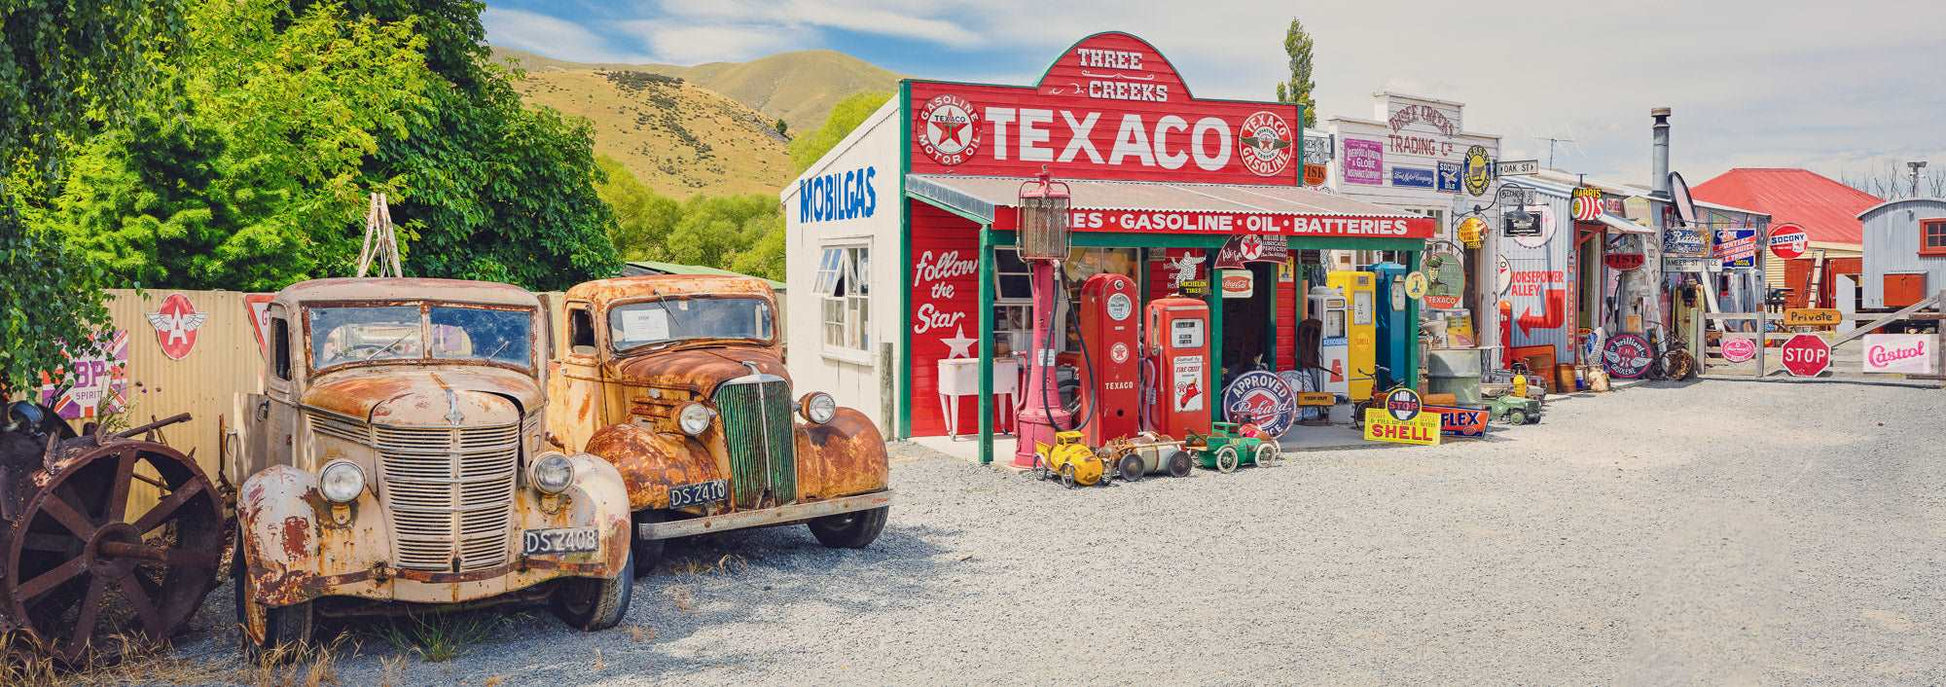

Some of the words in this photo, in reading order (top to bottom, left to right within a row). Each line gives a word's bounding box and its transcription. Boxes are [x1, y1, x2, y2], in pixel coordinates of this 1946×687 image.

[1077, 48, 1143, 70] THREE
[1088, 80, 1168, 102] CREEKS
[920, 94, 979, 121] GASOLINE
[934, 114, 966, 123] TEXACO
[1244, 113, 1287, 136] TEXACO
[1388, 104, 1419, 133] THREE
[1421, 105, 1455, 139] CREEKS
[985, 106, 1232, 171] TEXACO
[1388, 134, 1435, 156] TRADING
[918, 132, 962, 164] MOTOR
[965, 136, 981, 156] OIL
[1243, 147, 1289, 173] GASOLINE
[1356, 157, 1375, 169] GLOBE
[1503, 163, 1517, 173] OAK
[1521, 162, 1529, 172] ST
[1306, 166, 1326, 179] ISK
[800, 166, 877, 223] MOBILGAS
[1573, 188, 1601, 198] HARRIS
[1066, 213, 1103, 229] ES
[1120, 213, 1233, 231] GASOLINE
[1246, 215, 1280, 232] OIL
[1294, 217, 1408, 235] BATTERIES
[1771, 234, 1805, 244] SOCONY
[1511, 271, 1564, 283] HORSEPOWER
[931, 282, 955, 299] the
[1511, 284, 1540, 296] ALLEY
[1428, 296, 1456, 304] TEXACO
[914, 303, 965, 334] Star
[1791, 311, 1833, 322] Private
[1785, 348, 1826, 364] STOP
[1868, 340, 1925, 369] Castrol
[74, 360, 106, 388] BP
[1105, 381, 1133, 390] TEXACO
[1232, 375, 1288, 398] APPROVED
[1388, 401, 1418, 410] STOP
[1441, 412, 1480, 426] FLEX
[1372, 424, 1433, 441] SHELL
[671, 488, 692, 506] DS
[526, 531, 551, 552] DS
[555, 530, 596, 551] 2408
